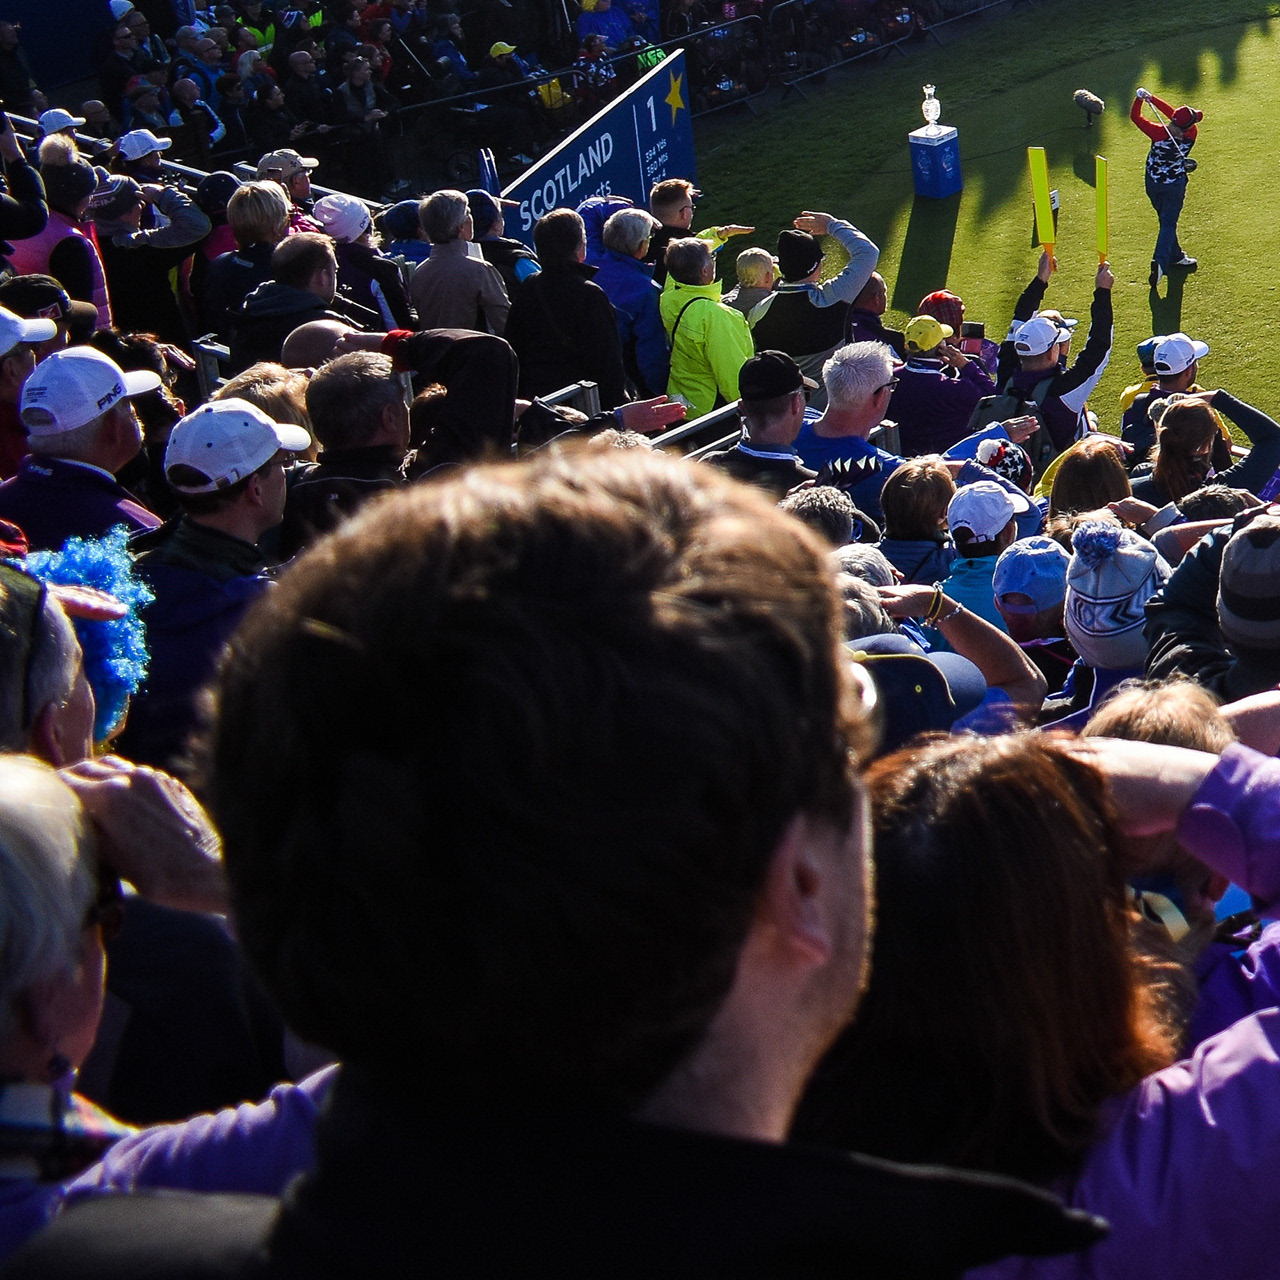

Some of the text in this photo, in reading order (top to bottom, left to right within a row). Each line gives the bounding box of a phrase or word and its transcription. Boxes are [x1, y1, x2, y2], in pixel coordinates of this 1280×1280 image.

[646, 96, 657, 132] 1
[520, 132, 614, 232] SCOTLAND
[97, 382, 122, 410] PING
